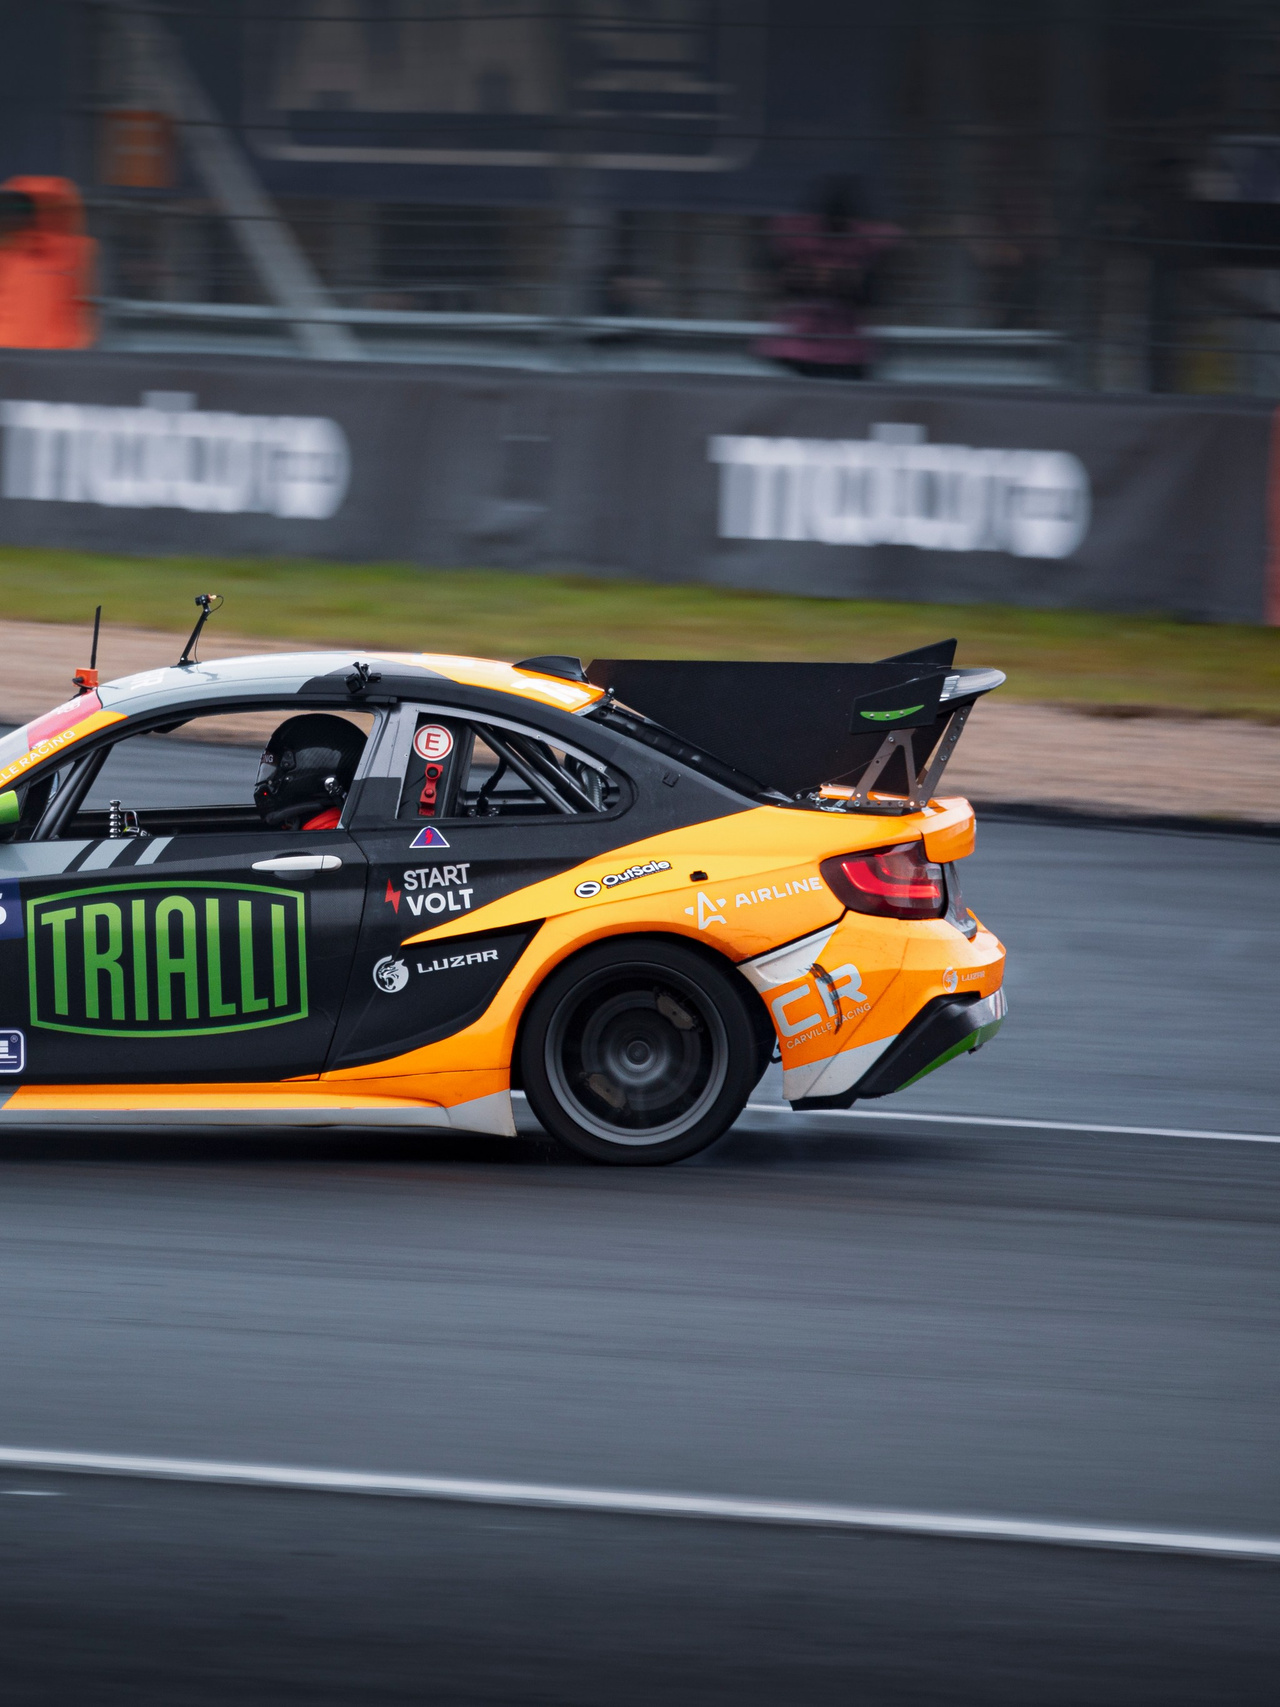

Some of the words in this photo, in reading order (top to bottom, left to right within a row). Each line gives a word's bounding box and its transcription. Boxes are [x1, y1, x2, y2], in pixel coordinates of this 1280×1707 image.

[19, 730, 76, 768] RACING
[425, 732, 441, 751] E
[403, 863, 471, 891] START
[602, 860, 671, 886] OutSale
[405, 888, 474, 917] VOLT
[735, 877, 823, 908] AIRLINE
[41, 895, 288, 1021] TRIALLI
[416, 949, 500, 974] LUZAR
[961, 970, 986, 982] LUZAR
[786, 1021, 833, 1050] CARVILLE
